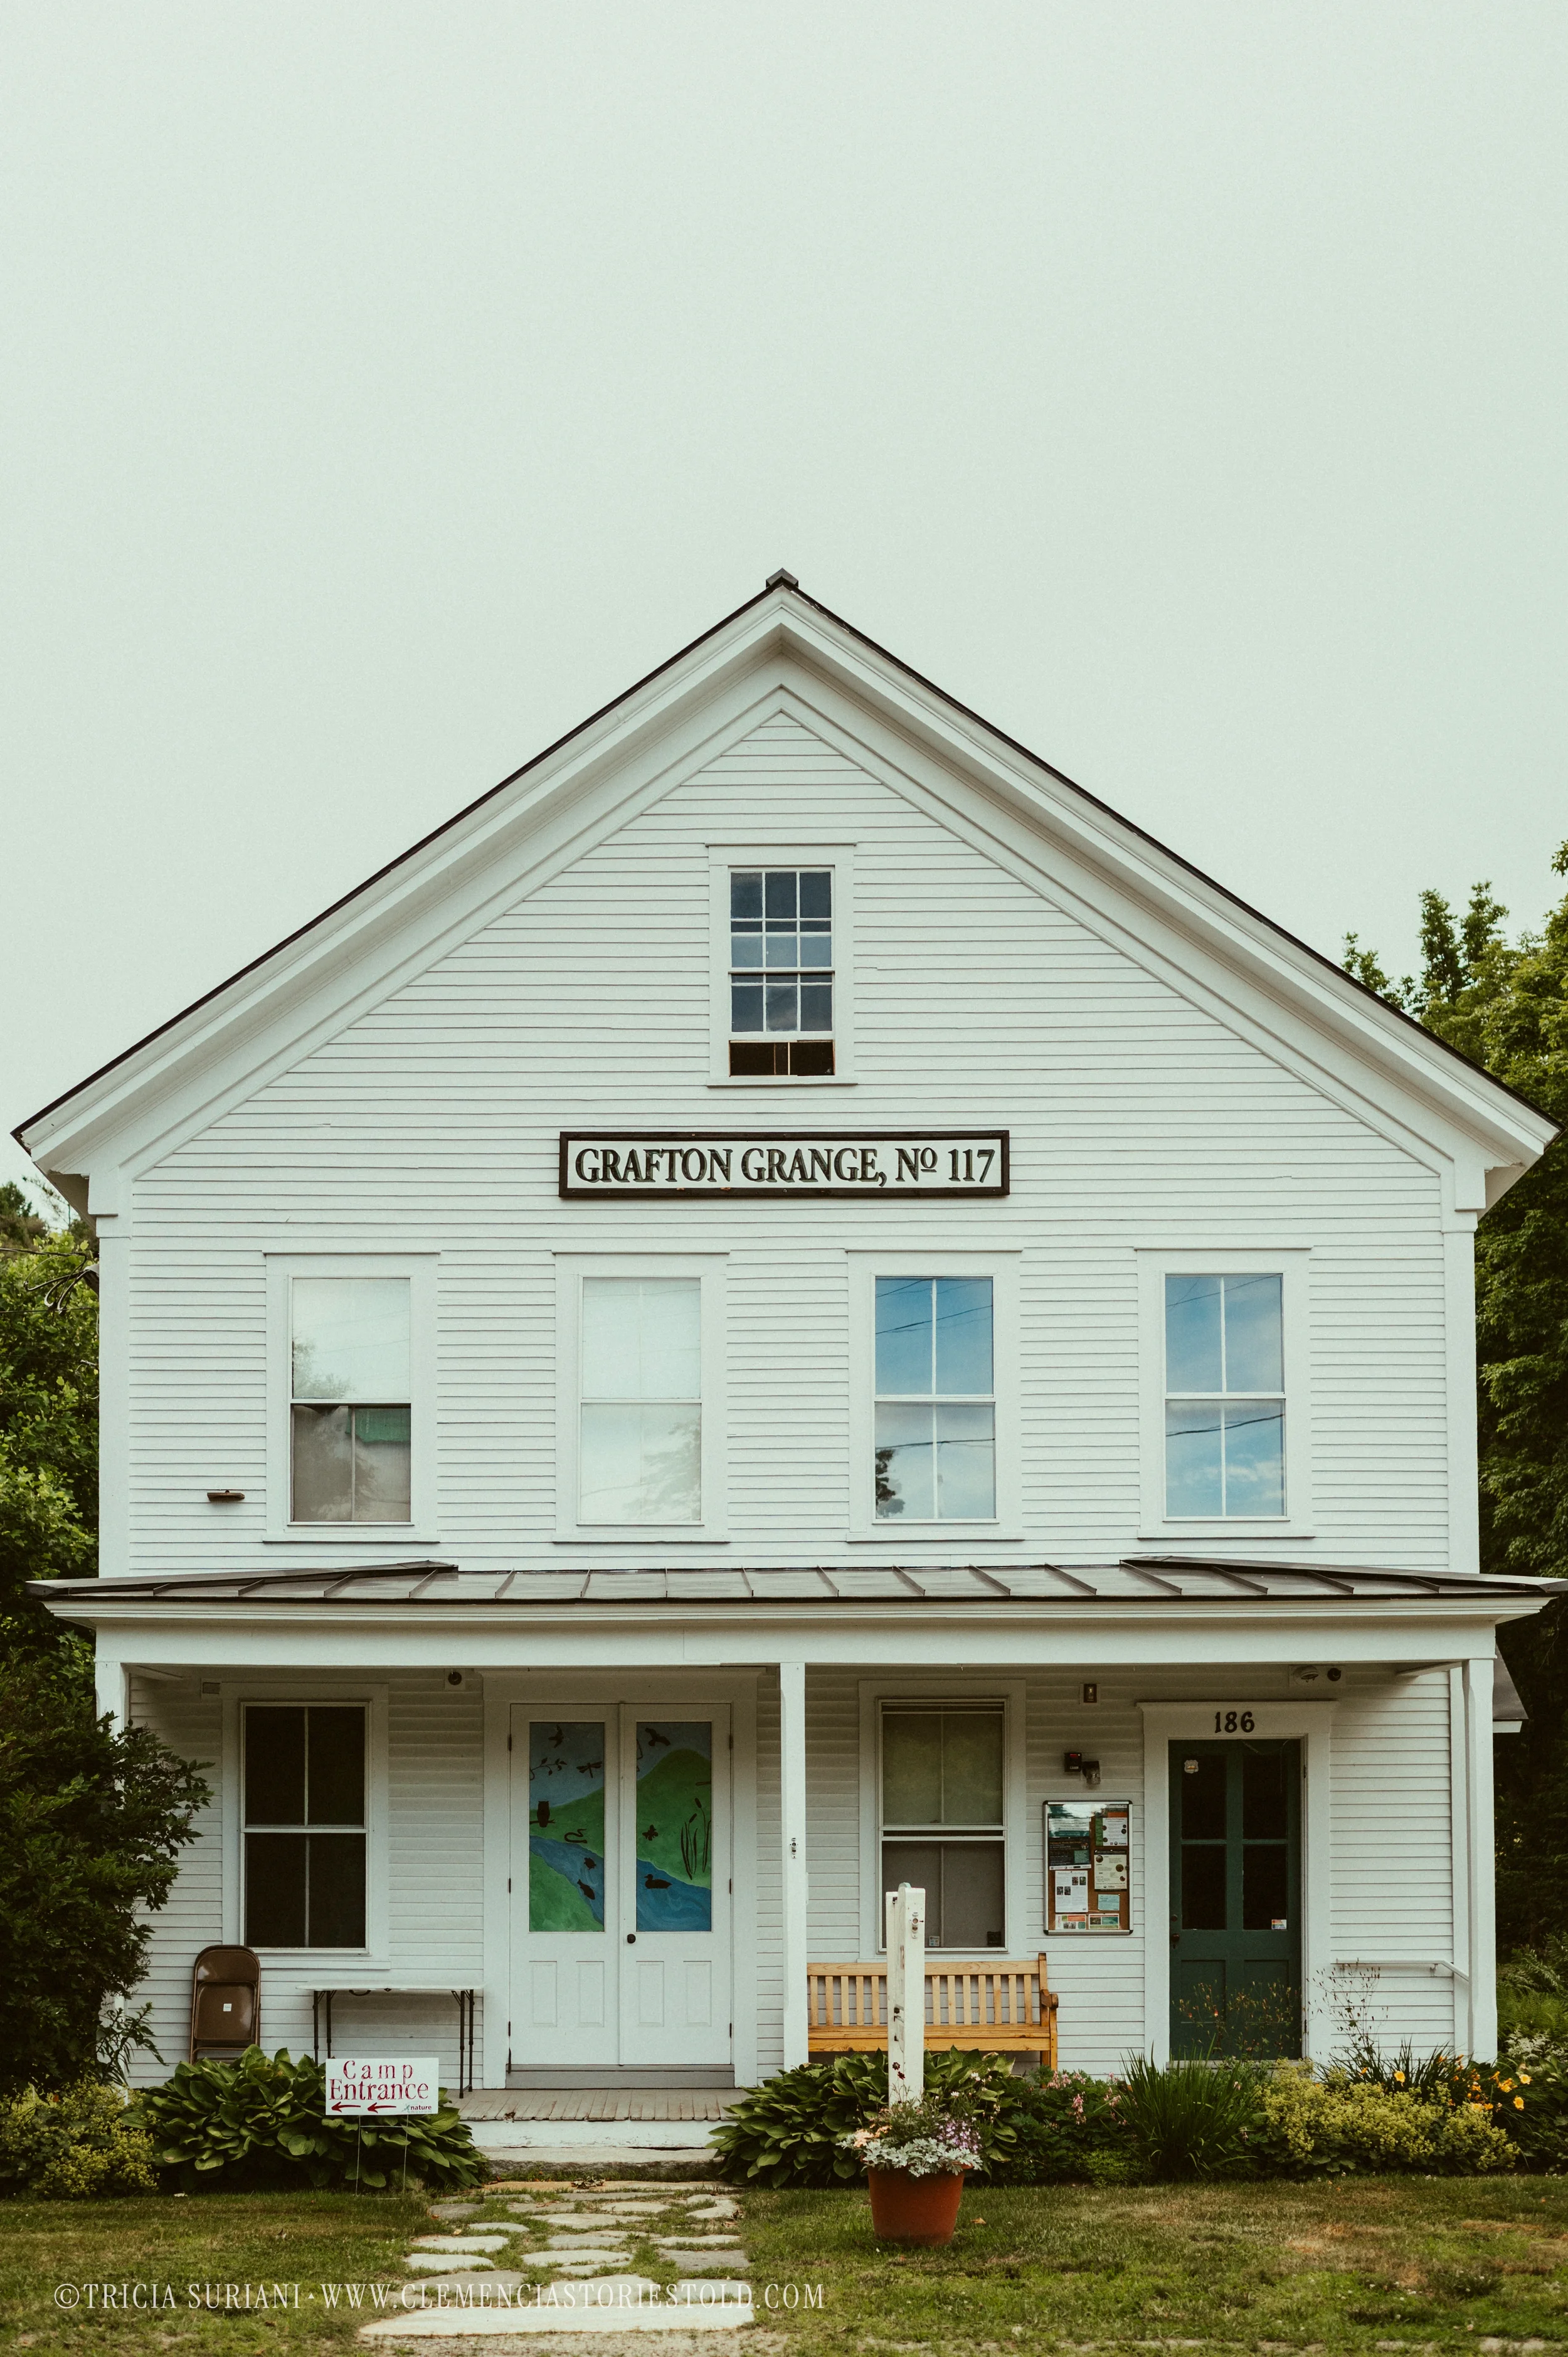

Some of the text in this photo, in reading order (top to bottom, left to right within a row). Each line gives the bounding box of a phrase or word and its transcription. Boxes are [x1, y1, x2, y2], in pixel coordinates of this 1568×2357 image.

[576, 1148, 733, 1183] GRAFTON
[741, 1148, 887, 1187] GRANGE,
[948, 1148, 996, 1183] 117
[1214, 1711, 1255, 1734] 186
[343, 2060, 413, 2085] Camp
[329, 2079, 429, 2100] Entrance
